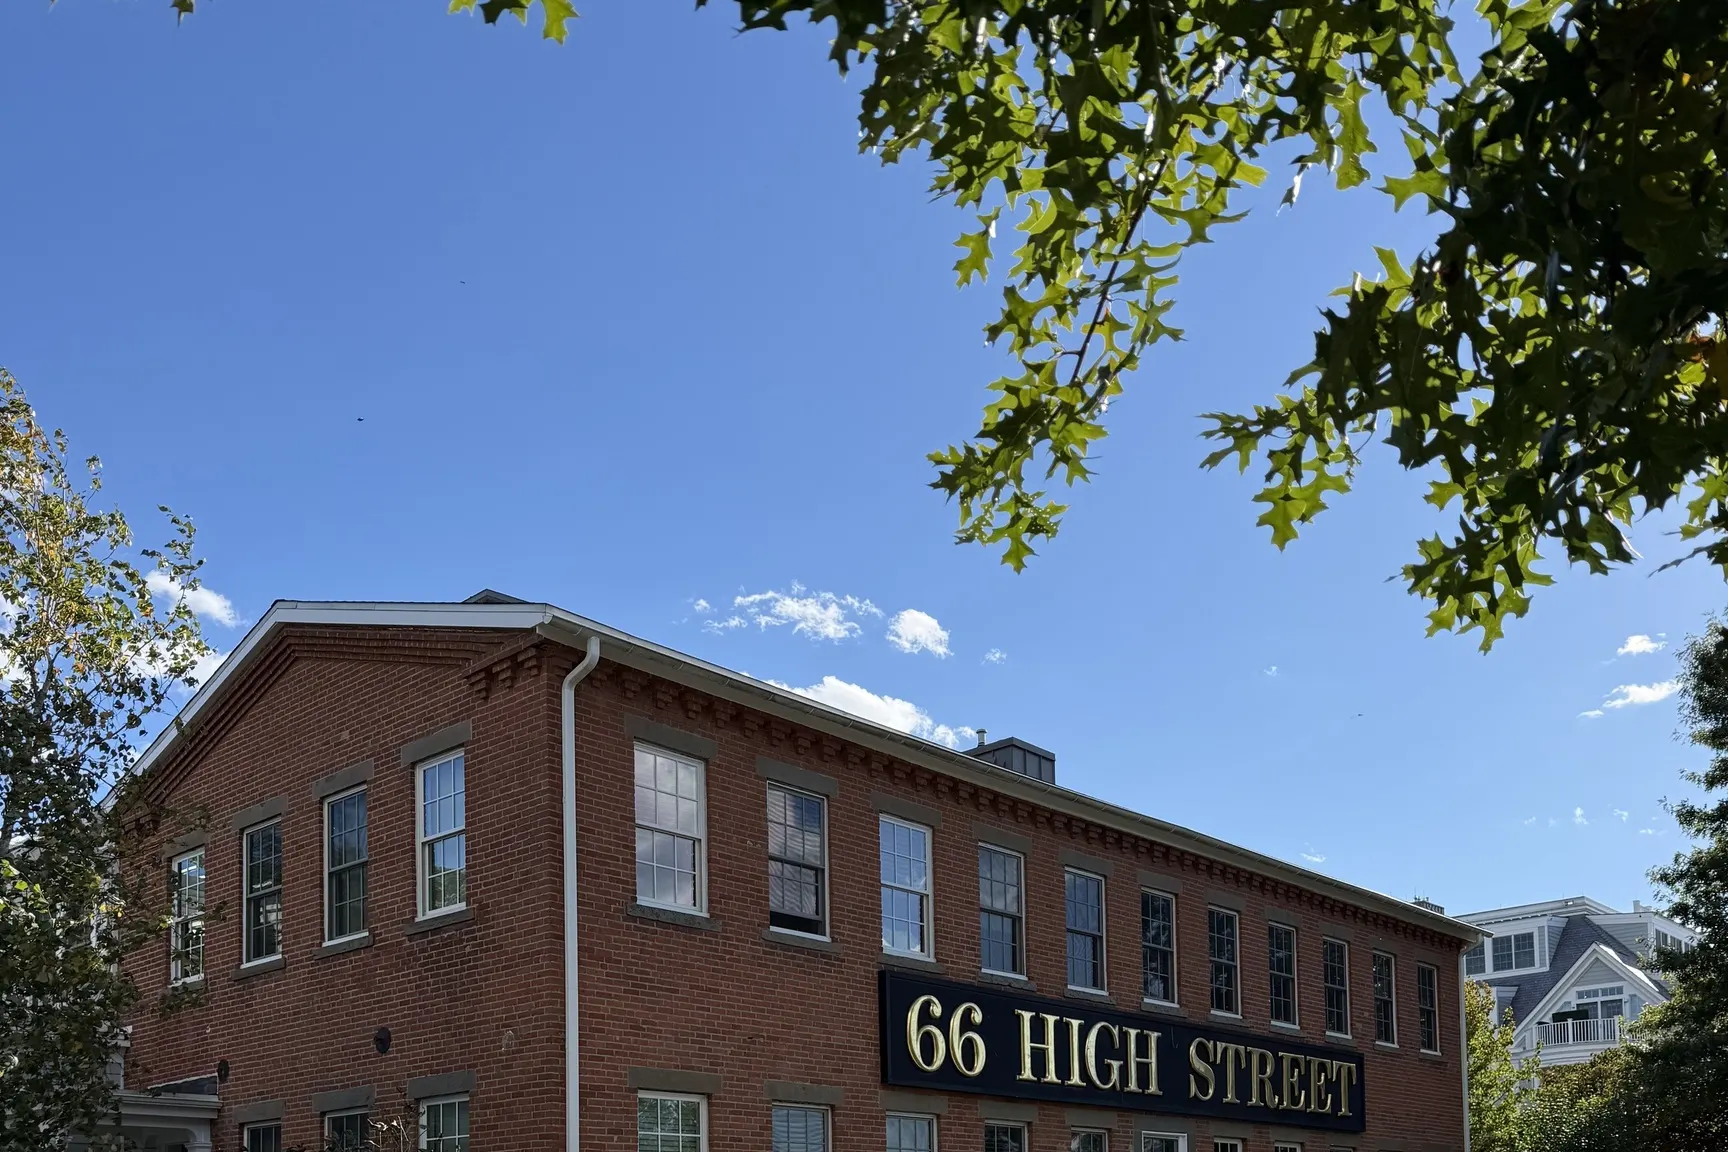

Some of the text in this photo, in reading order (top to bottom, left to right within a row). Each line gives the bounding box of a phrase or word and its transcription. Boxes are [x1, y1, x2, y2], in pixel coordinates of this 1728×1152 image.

[906, 994, 1358, 1117] 66 HIGH STREET
